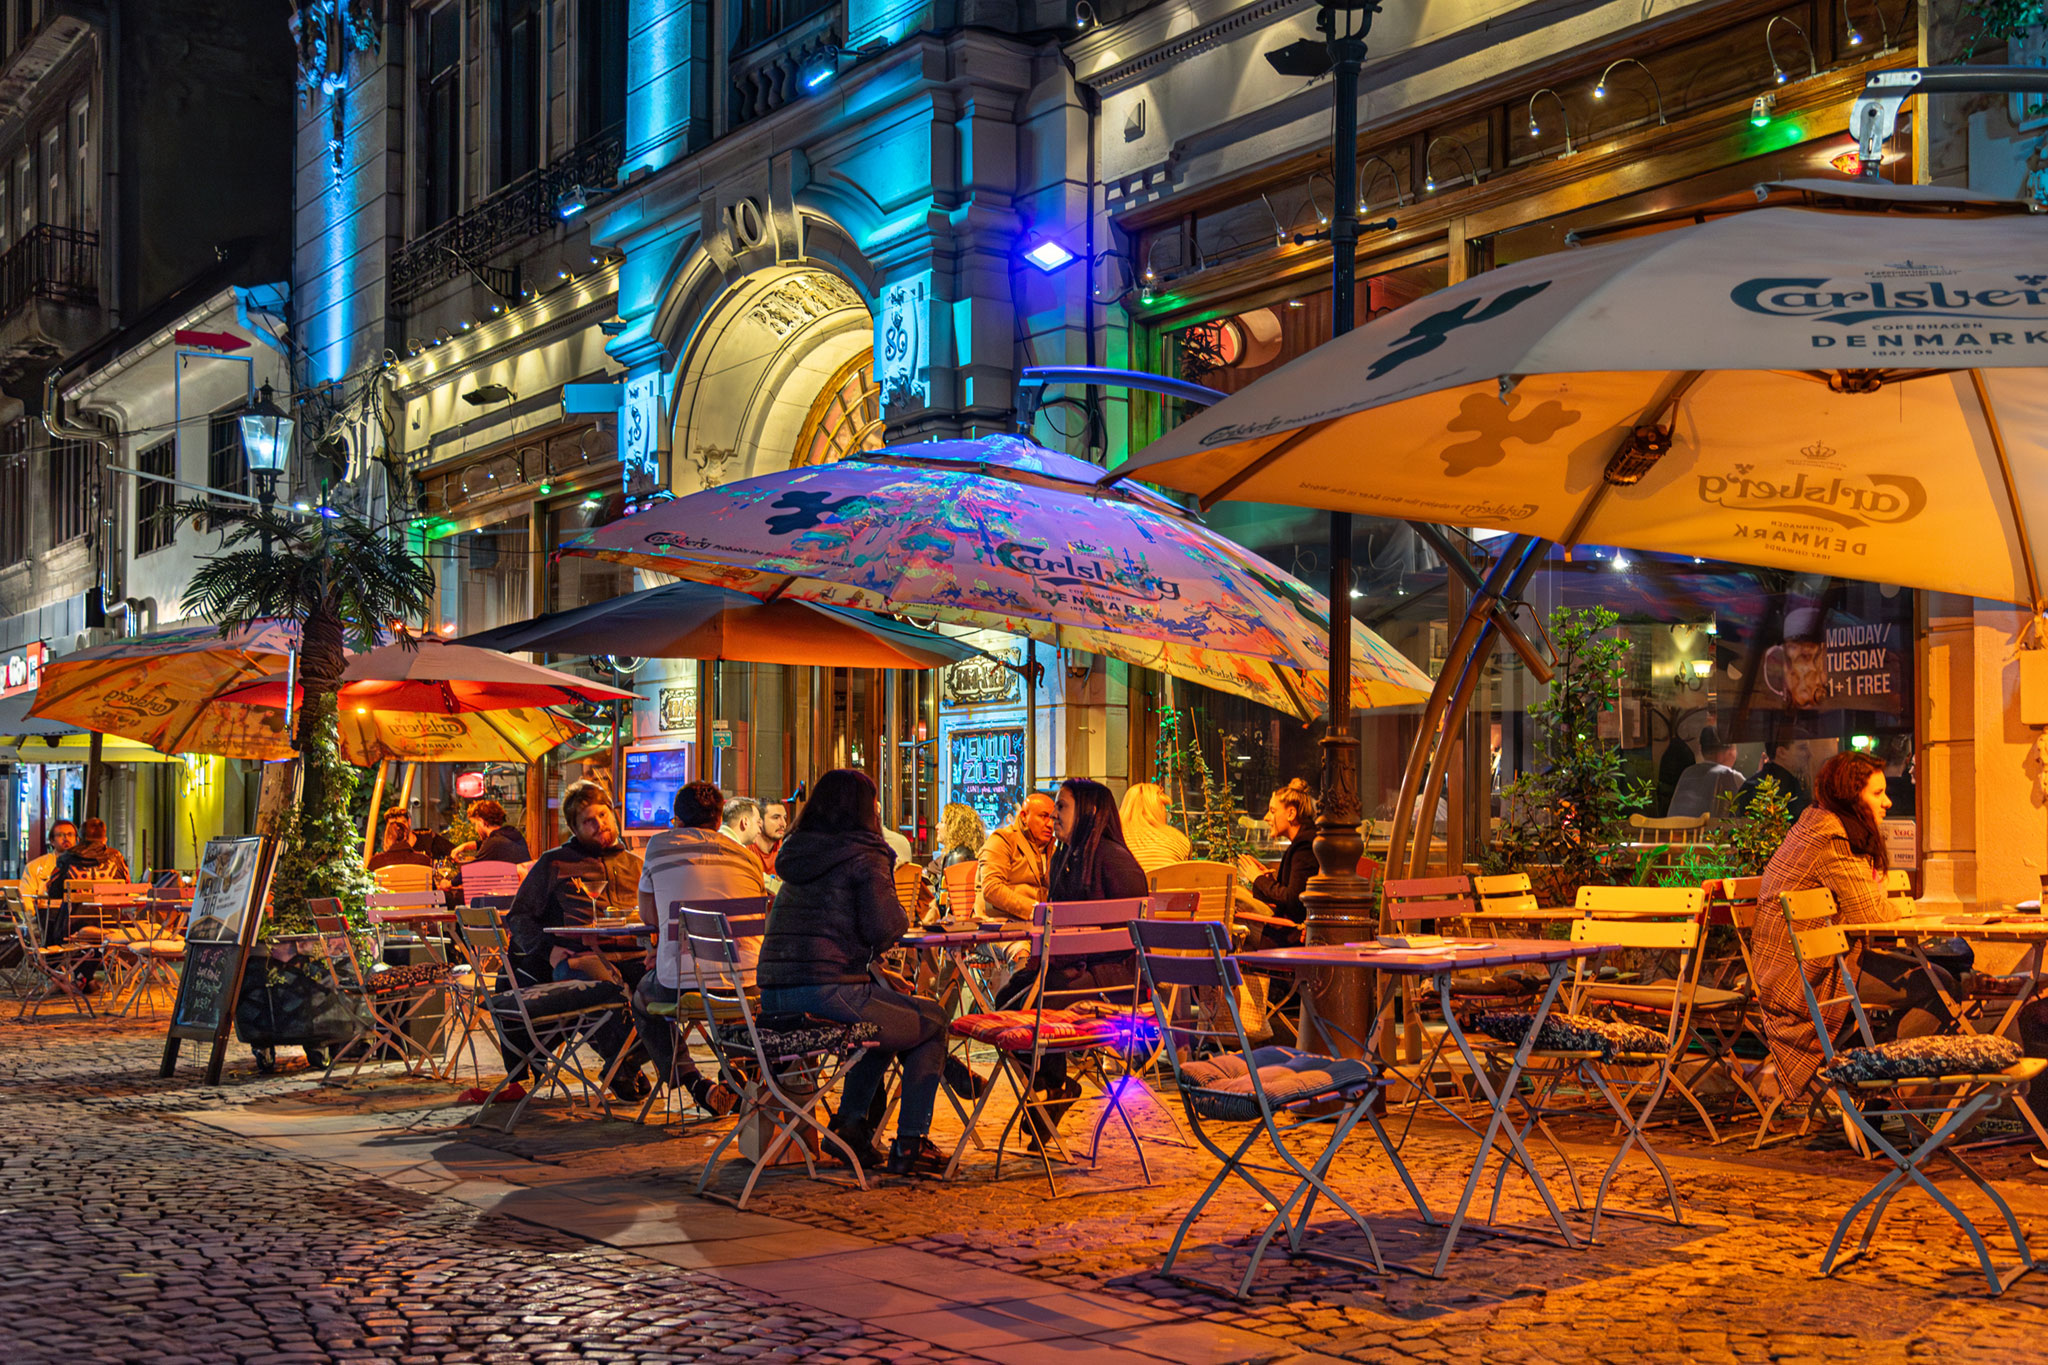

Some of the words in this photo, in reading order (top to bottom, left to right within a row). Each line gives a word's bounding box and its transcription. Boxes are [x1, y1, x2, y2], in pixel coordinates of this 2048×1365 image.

[723, 197, 767, 252] 10
[1730, 278, 2048, 318] Carlsber
[1872, 322, 1983, 331] COPENHAGEN
[1811, 331, 2048, 347] DENMARK
[1912, 348, 1993, 357] ONWARDS
[644, 531, 711, 550] Carlsberg
[996, 542, 1181, 601] Carlsbg
[1826, 622, 1892, 648] MONDAY/
[1827, 648, 1886, 673] TUESDAY
[1828, 676, 1852, 697] 1+1
[1856, 673, 1891, 696] FREE
